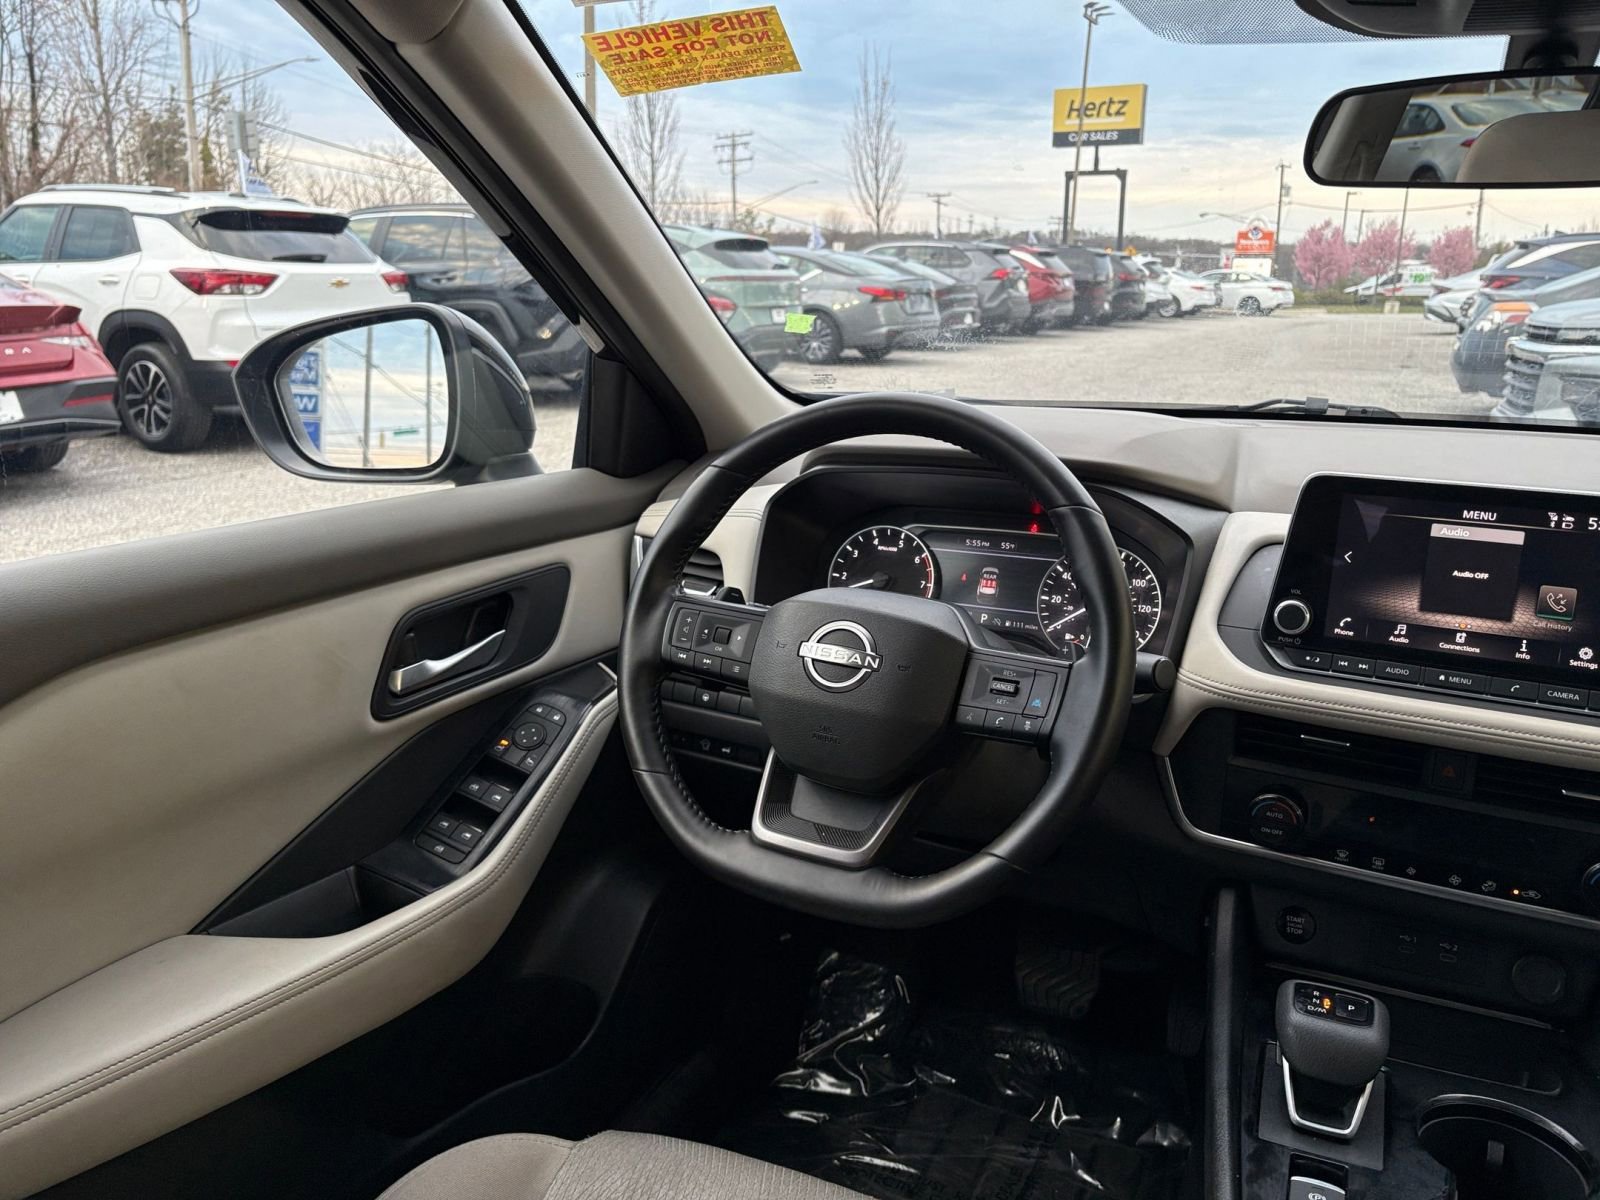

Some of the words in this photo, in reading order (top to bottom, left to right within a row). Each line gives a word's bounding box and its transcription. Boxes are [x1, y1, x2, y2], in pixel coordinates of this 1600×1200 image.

[1067, 97, 1130, 119] Hertz
[1463, 510, 1497, 520] MENU
[1440, 527, 1470, 537] Audio
[873, 538, 879, 546] 4
[899, 540, 904, 548] 5
[966, 539, 981, 547] 5:55
[853, 549, 859, 558] 3
[914, 556, 920, 564] 6
[841, 571, 848, 580] 2
[1452, 570, 1474, 579] Audio
[1474, 572, 1489, 580] OFF
[920, 580, 926, 589] 7
[1132, 579, 1146, 588] 100
[1051, 595, 1062, 604] 20
[1138, 604, 1152, 613] 120
[980, 613, 988, 623] P
[1533, 620, 1547, 629] Call
[1547, 622, 1573, 632] History
[1334, 628, 1354, 637] Phone
[1389, 635, 1410, 644] Audio
[1439, 642, 1481, 654] Connections
[803, 644, 879, 669] NISSAN
[1515, 652, 1531, 660] Info
[1569, 659, 1599, 670] Settings
[1385, 666, 1410, 676] AUDIO
[1449, 675, 1472, 685] MENU
[991, 681, 1014, 692] CANCEL
[1547, 690, 1580, 701] CAMERA
[1265, 811, 1284, 819] AUTO
[1286, 915, 1305, 924] START
[1285, 926, 1304, 935] STOP
